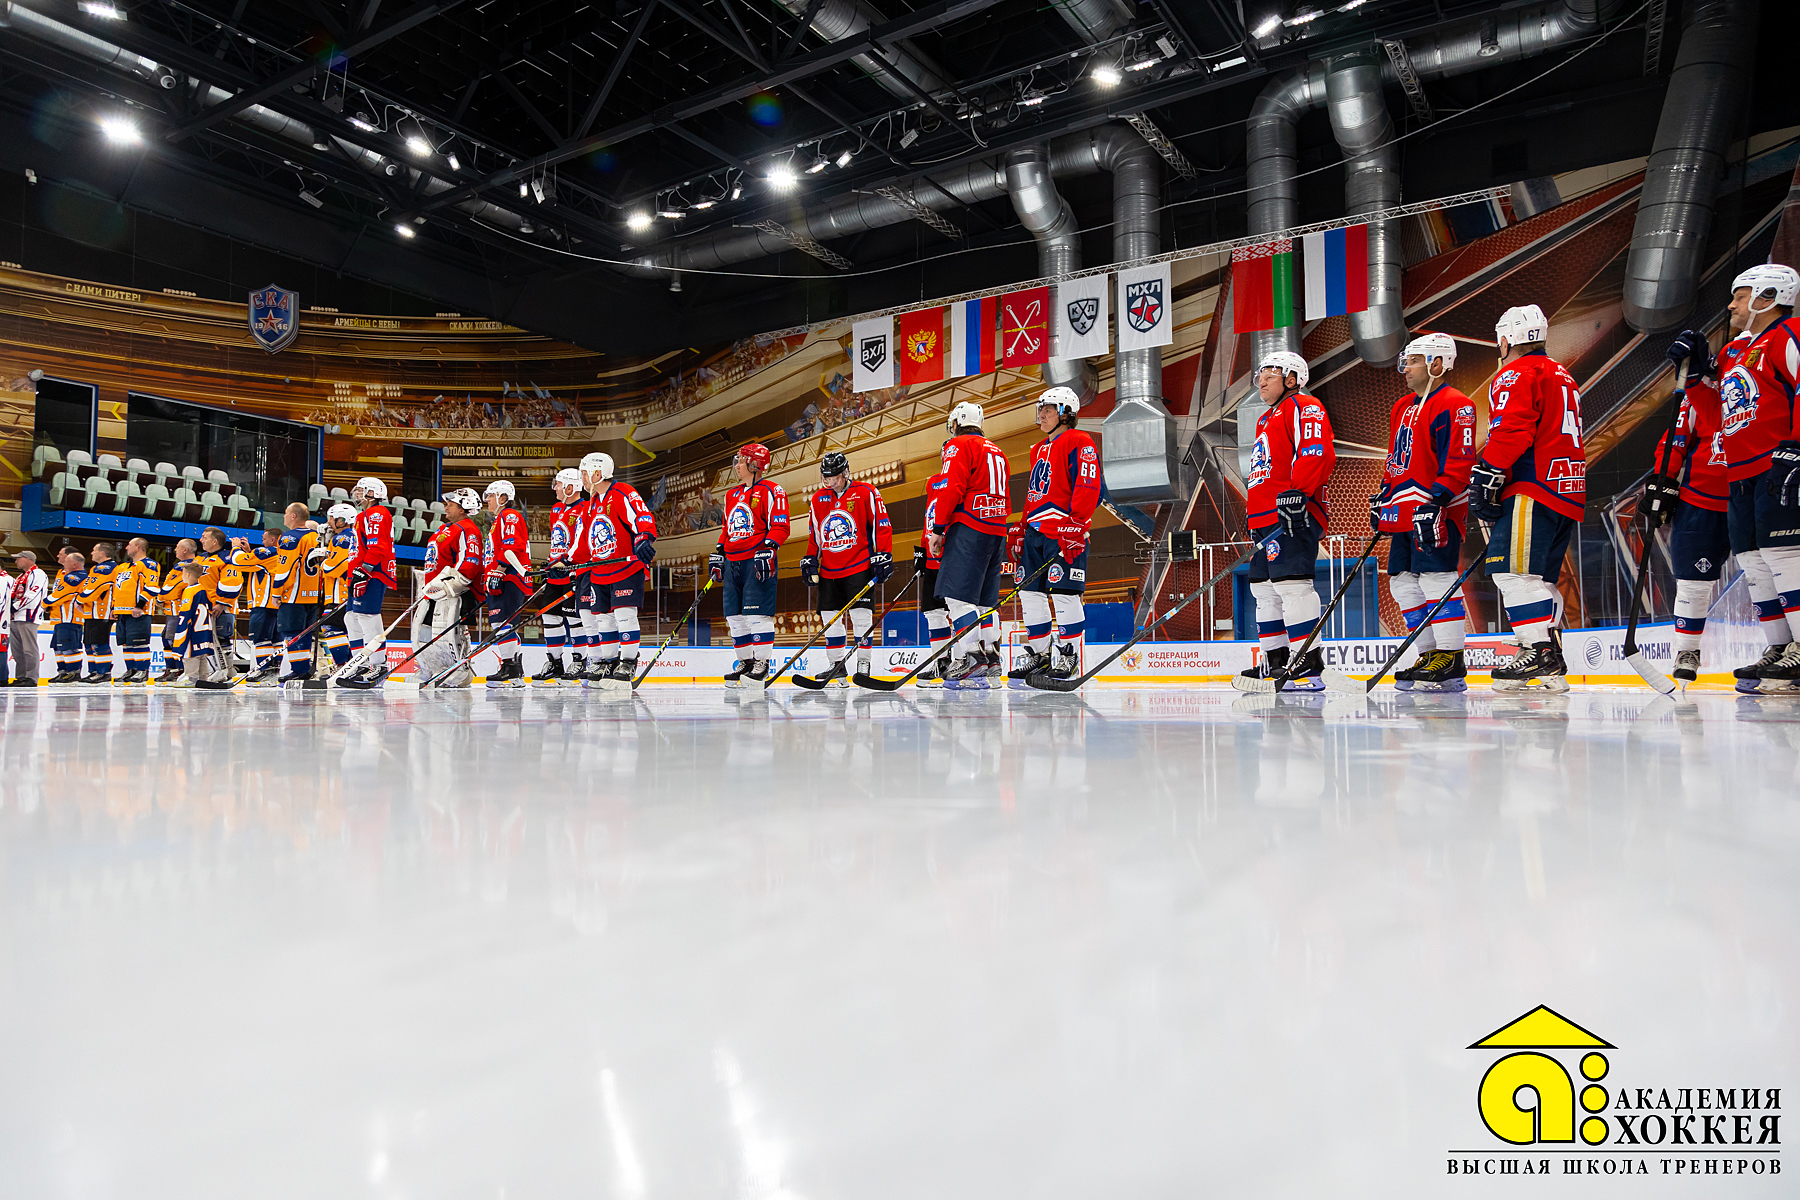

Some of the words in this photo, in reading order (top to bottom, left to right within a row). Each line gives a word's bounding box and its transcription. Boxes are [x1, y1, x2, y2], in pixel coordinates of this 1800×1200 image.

[65, 283, 72, 292] С
[73, 284, 102, 296] НАМИ
[1128, 282, 1161, 298] МХЛ
[252, 291, 288, 310] СКА
[1528, 329, 1541, 341] 67
[862, 342, 884, 362] ВХЛ
[1304, 422, 1322, 439] 66
[1463, 427, 1473, 446] 8
[449, 446, 475, 456] ТОЛЬКО
[476, 446, 493, 456] СКА!
[495, 446, 522, 456] ТОЛЬКО
[523, 446, 555, 457] ПОБЕДА!
[987, 452, 1006, 497] 10
[1081, 462, 1097, 478] 68
[777, 497, 785, 510] 11
[1276, 496, 1303, 505] RRIOR
[878, 501, 887, 513] 15
[469, 543, 479, 555] 30
[870, 553, 888, 563] STX
[1072, 571, 1083, 579] ACT
[388, 651, 406, 659] ЗДЕСЬ
[1147, 651, 1199, 660] ФЕДЕРАЦИЯ
[1464, 648, 1495, 657] КУБОК
[1610, 642, 1671, 660] ГАЗОМБАНК
[637, 660, 686, 668] EMSKA.RU
[889, 651, 917, 665] Chili
[1148, 660, 1181, 668] ХОККЕЯ
[1184, 660, 1220, 668] РОССИИ
[1464, 655, 1514, 666] ПИОНОВ
